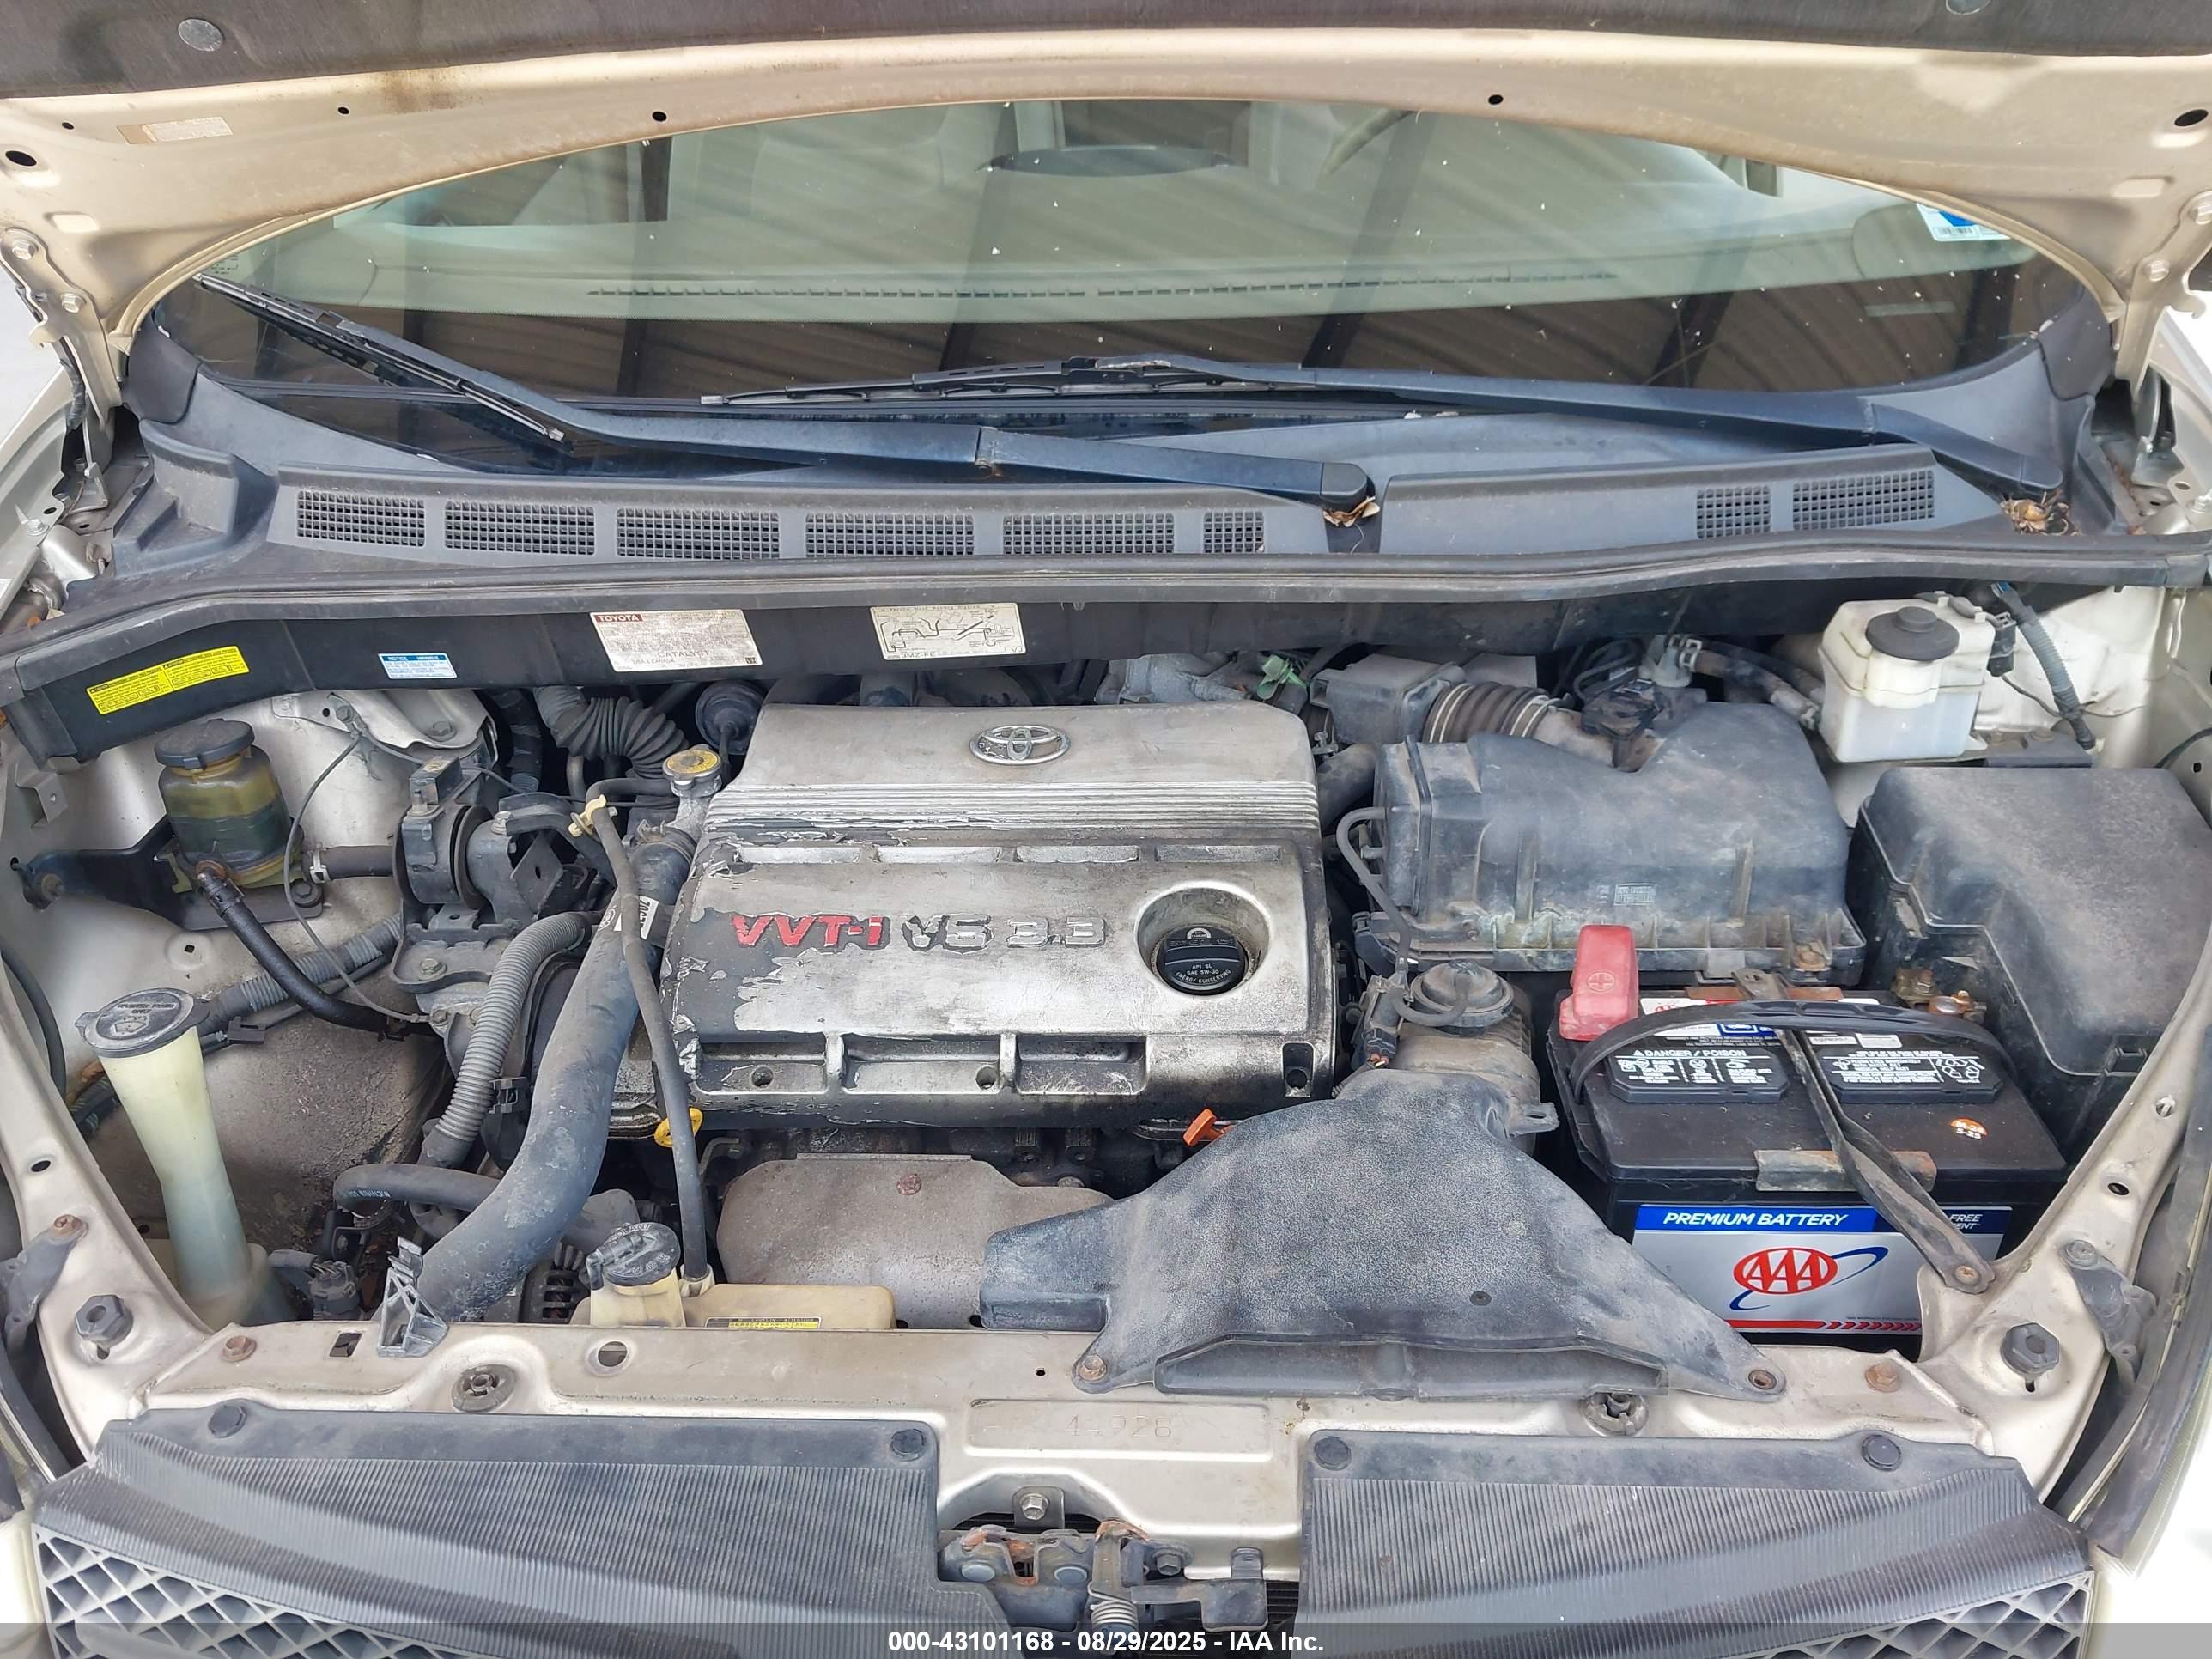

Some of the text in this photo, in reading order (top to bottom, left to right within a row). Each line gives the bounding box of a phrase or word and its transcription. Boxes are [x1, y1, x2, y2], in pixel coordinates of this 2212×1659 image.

[658, 650, 709, 659] CATALYST
[732, 915, 1106, 949] VVT-i V6 3.3
[1176, 969, 1231, 983] ENERGY CONSERVING
[1663, 1212, 1849, 1227] PREMIUM BATTERY
[1949, 1213, 1984, 1223] FREE
[1742, 1249, 1829, 1294] AAA
